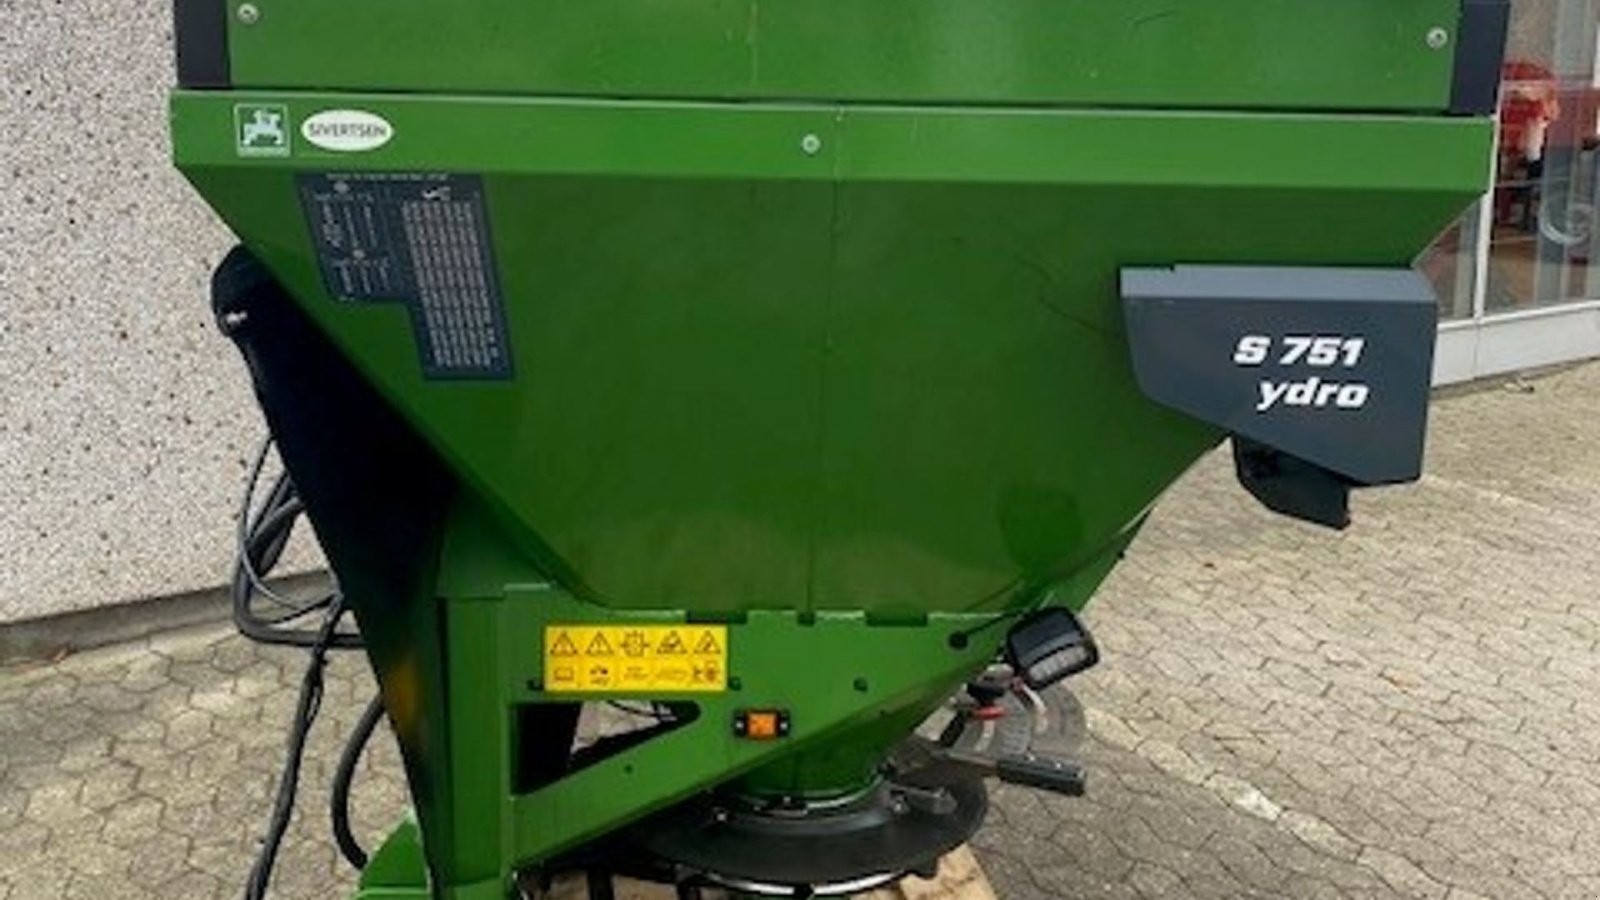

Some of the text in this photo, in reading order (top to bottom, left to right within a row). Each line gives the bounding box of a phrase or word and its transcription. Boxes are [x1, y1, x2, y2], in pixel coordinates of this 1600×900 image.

[308, 122, 387, 137] SIVERTSEN
[1233, 335, 1365, 366] S 751
[1256, 376, 1369, 411] ydro
